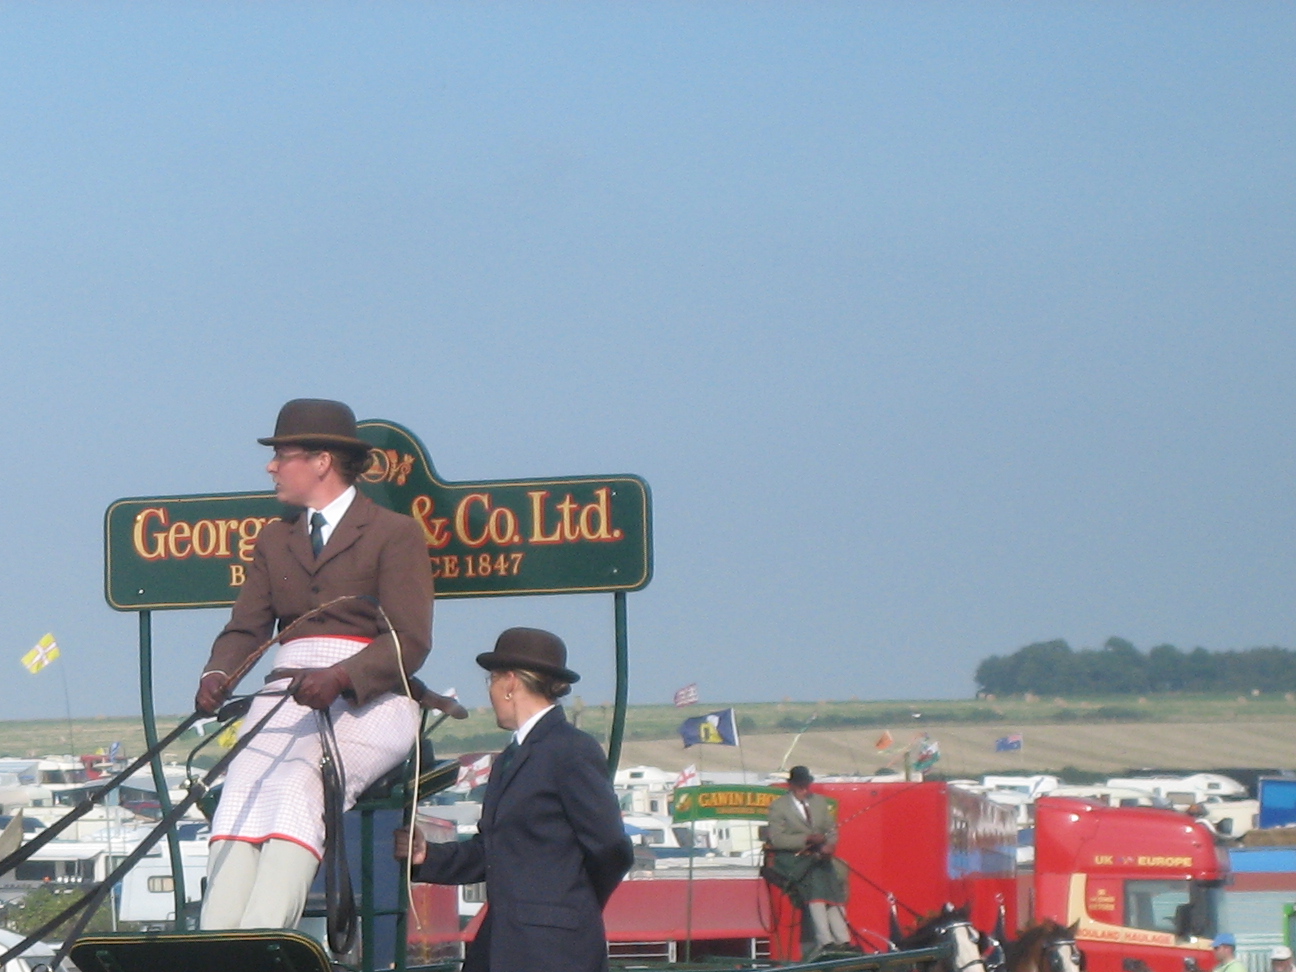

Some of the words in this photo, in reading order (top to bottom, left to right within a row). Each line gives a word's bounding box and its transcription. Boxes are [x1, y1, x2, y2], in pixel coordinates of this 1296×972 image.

[411, 495, 452, 549] &
[455, 492, 522, 547] Co.
[526, 486, 624, 545] Ltd.
[465, 552, 525, 577] 1847
[1094, 855, 1114, 866] UK
[1137, 856, 1193, 868] EUROPE
